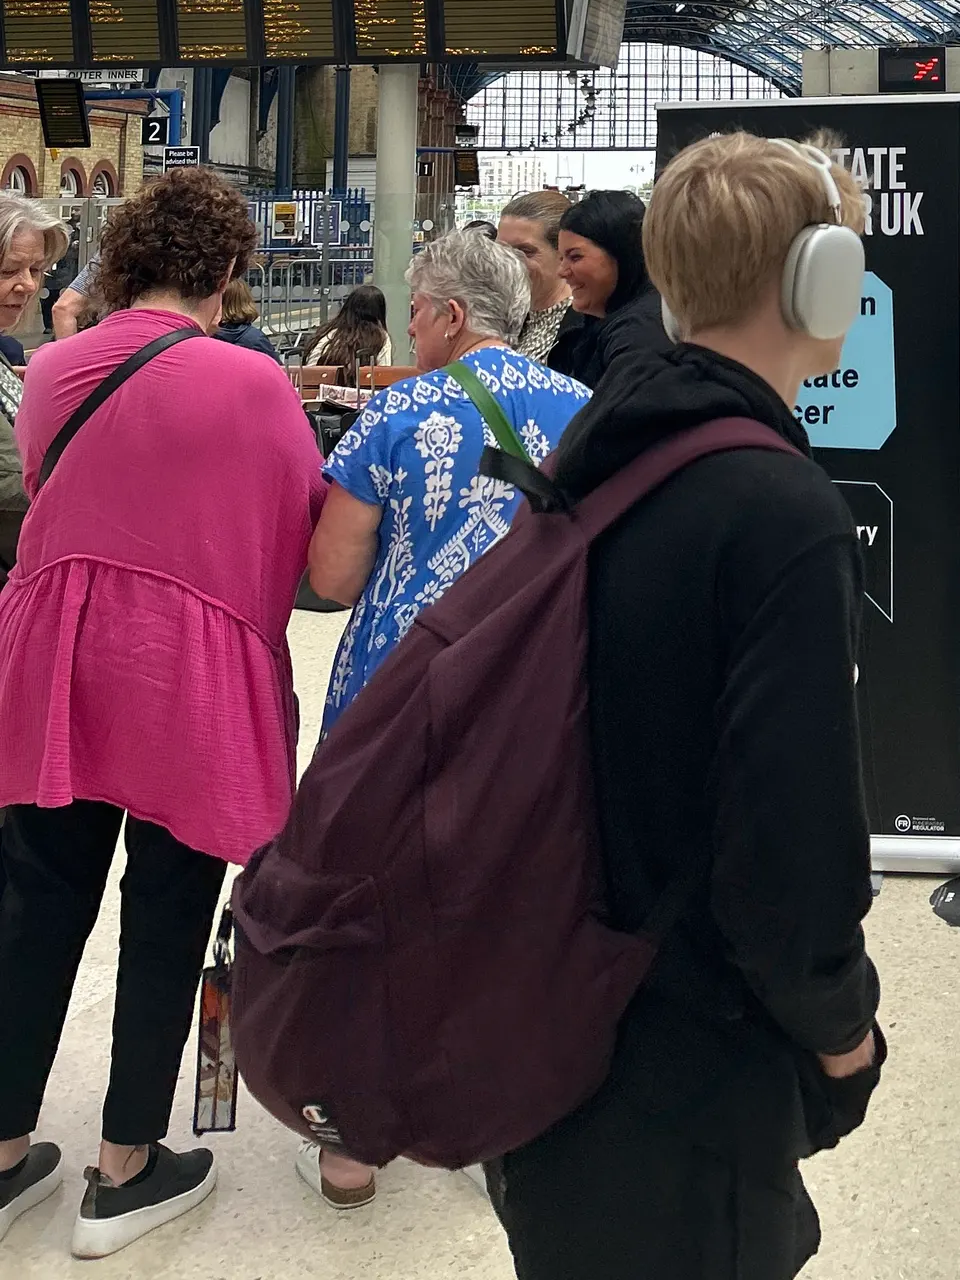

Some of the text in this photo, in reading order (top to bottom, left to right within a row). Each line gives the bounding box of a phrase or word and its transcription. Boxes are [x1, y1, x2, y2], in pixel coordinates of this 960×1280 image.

[68, 70, 138, 80] OUTER INNER
[148, 122, 160, 141] 2
[831, 147, 906, 190] TATE
[881, 192, 924, 236] UK
